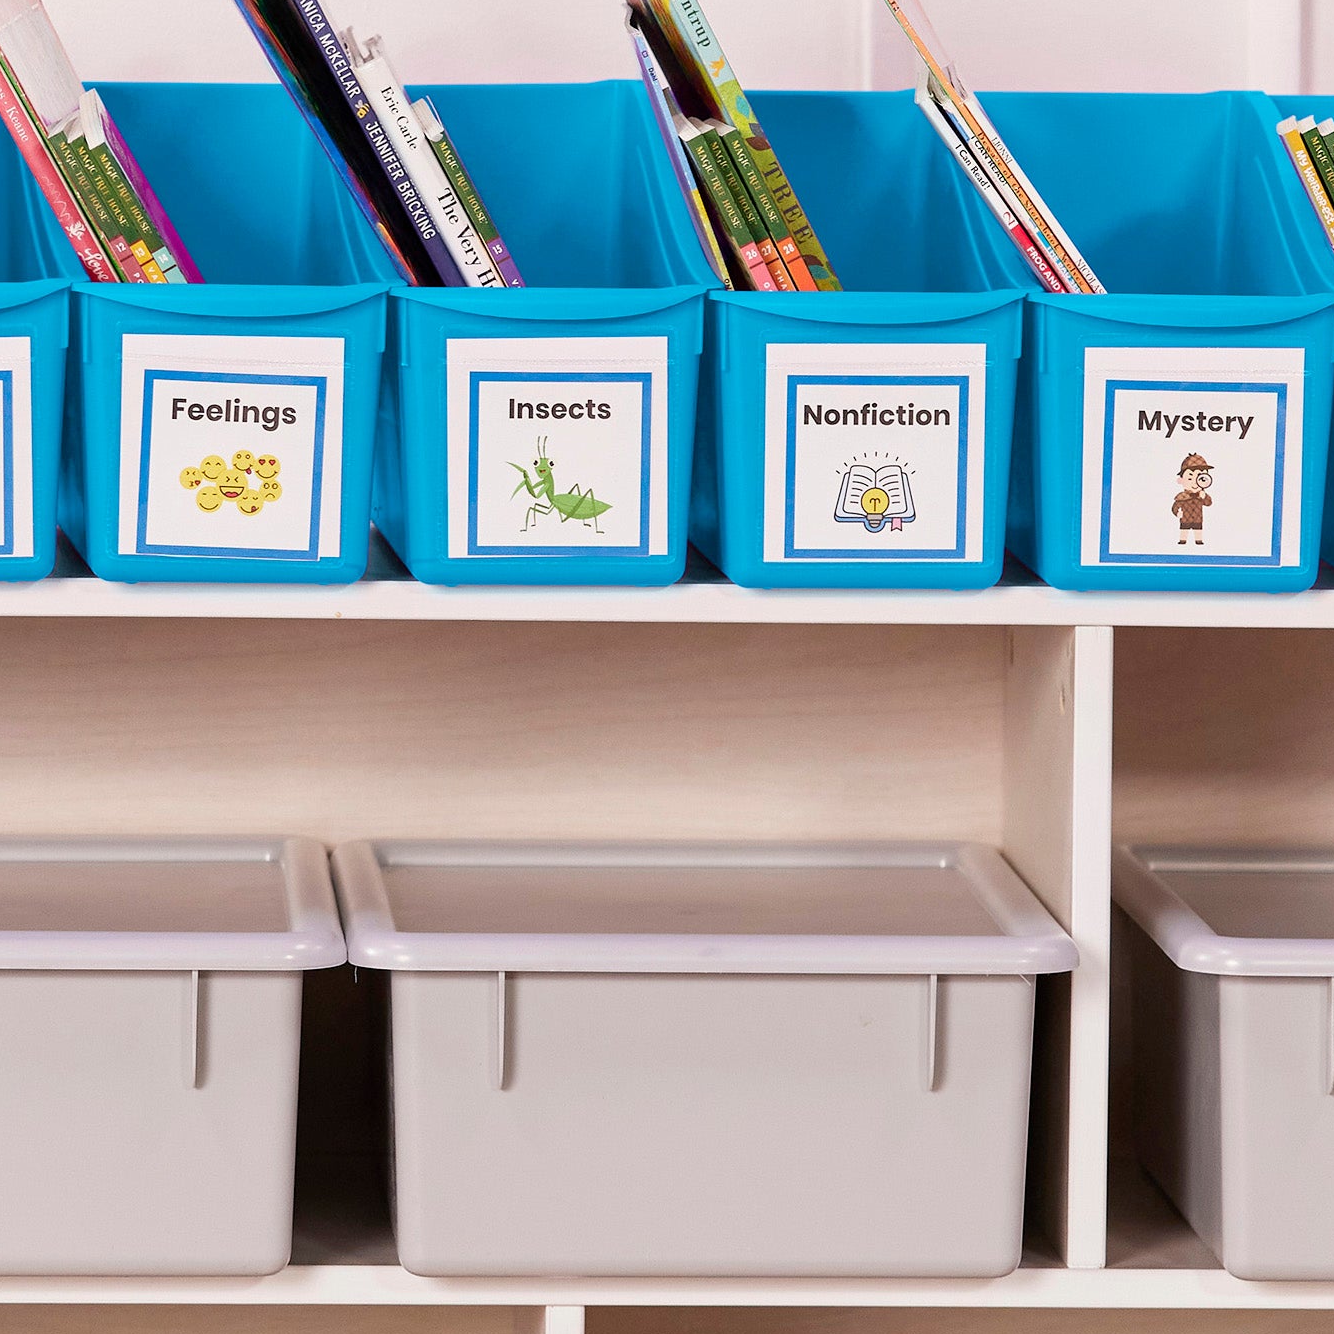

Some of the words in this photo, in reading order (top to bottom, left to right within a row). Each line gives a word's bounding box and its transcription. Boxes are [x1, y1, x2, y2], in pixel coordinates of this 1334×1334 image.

[6, 106, 29, 143] Keane
[380, 86, 399, 116] Eric
[396, 115, 418, 151] Carle
[974, 140, 988, 159] CAN
[992, 137, 1013, 164] LIONNI
[1296, 150, 1308, 166] My
[1311, 136, 1329, 168] MAGIC
[59, 141, 78, 174] MAGIC
[76, 171, 91, 192] TREE
[90, 193, 109, 223] HOUSE
[78, 146, 98, 179] MAGIC
[95, 175, 110, 197] TREE
[108, 198, 128, 227] HOUSE
[365, 121, 405, 182] JENNIFER
[397, 180, 436, 241] BRICKING
[440, 141, 458, 171] MAGIC
[455, 171, 470, 195] TREE
[467, 194, 487, 225] HOUSE
[695, 146, 715, 175] MAGIC
[710, 175, 725, 197] TREE
[722, 199, 740, 229] HOUSE
[710, 141, 729, 171] MAGIC
[726, 172, 740, 193] TREE
[738, 194, 756, 226] HOUSE
[731, 139, 750, 170] MAGIC
[747, 170, 761, 191] TREE
[758, 193, 778, 224] HOUSE
[959, 149, 972, 166] Can
[971, 165, 991, 190] Read!
[99, 153, 118, 182] MAGIC
[117, 182, 133, 203] TREE
[130, 205, 150, 234] HOUSE
[763, 160, 813, 244] TREE
[437, 187, 459, 225] The
[455, 227, 482, 269] Very
[1003, 170, 1013, 179] of
[1012, 183, 1024, 198] the
[1061, 252, 1083, 286] Wolves
[78, 248, 109, 282] Love
[491, 244, 503, 255] 15
[745, 249, 758, 260] 26
[761, 245, 772, 256] 27
[782, 243, 795, 255] 28
[1027, 246, 1048, 271] FROG
[1043, 270, 1061, 291] AND
[171, 397, 298, 432] Feelings
[508, 398, 612, 421] Insects
[803, 403, 951, 427] Nonfiction
[1137, 409, 1255, 440] Mystery
